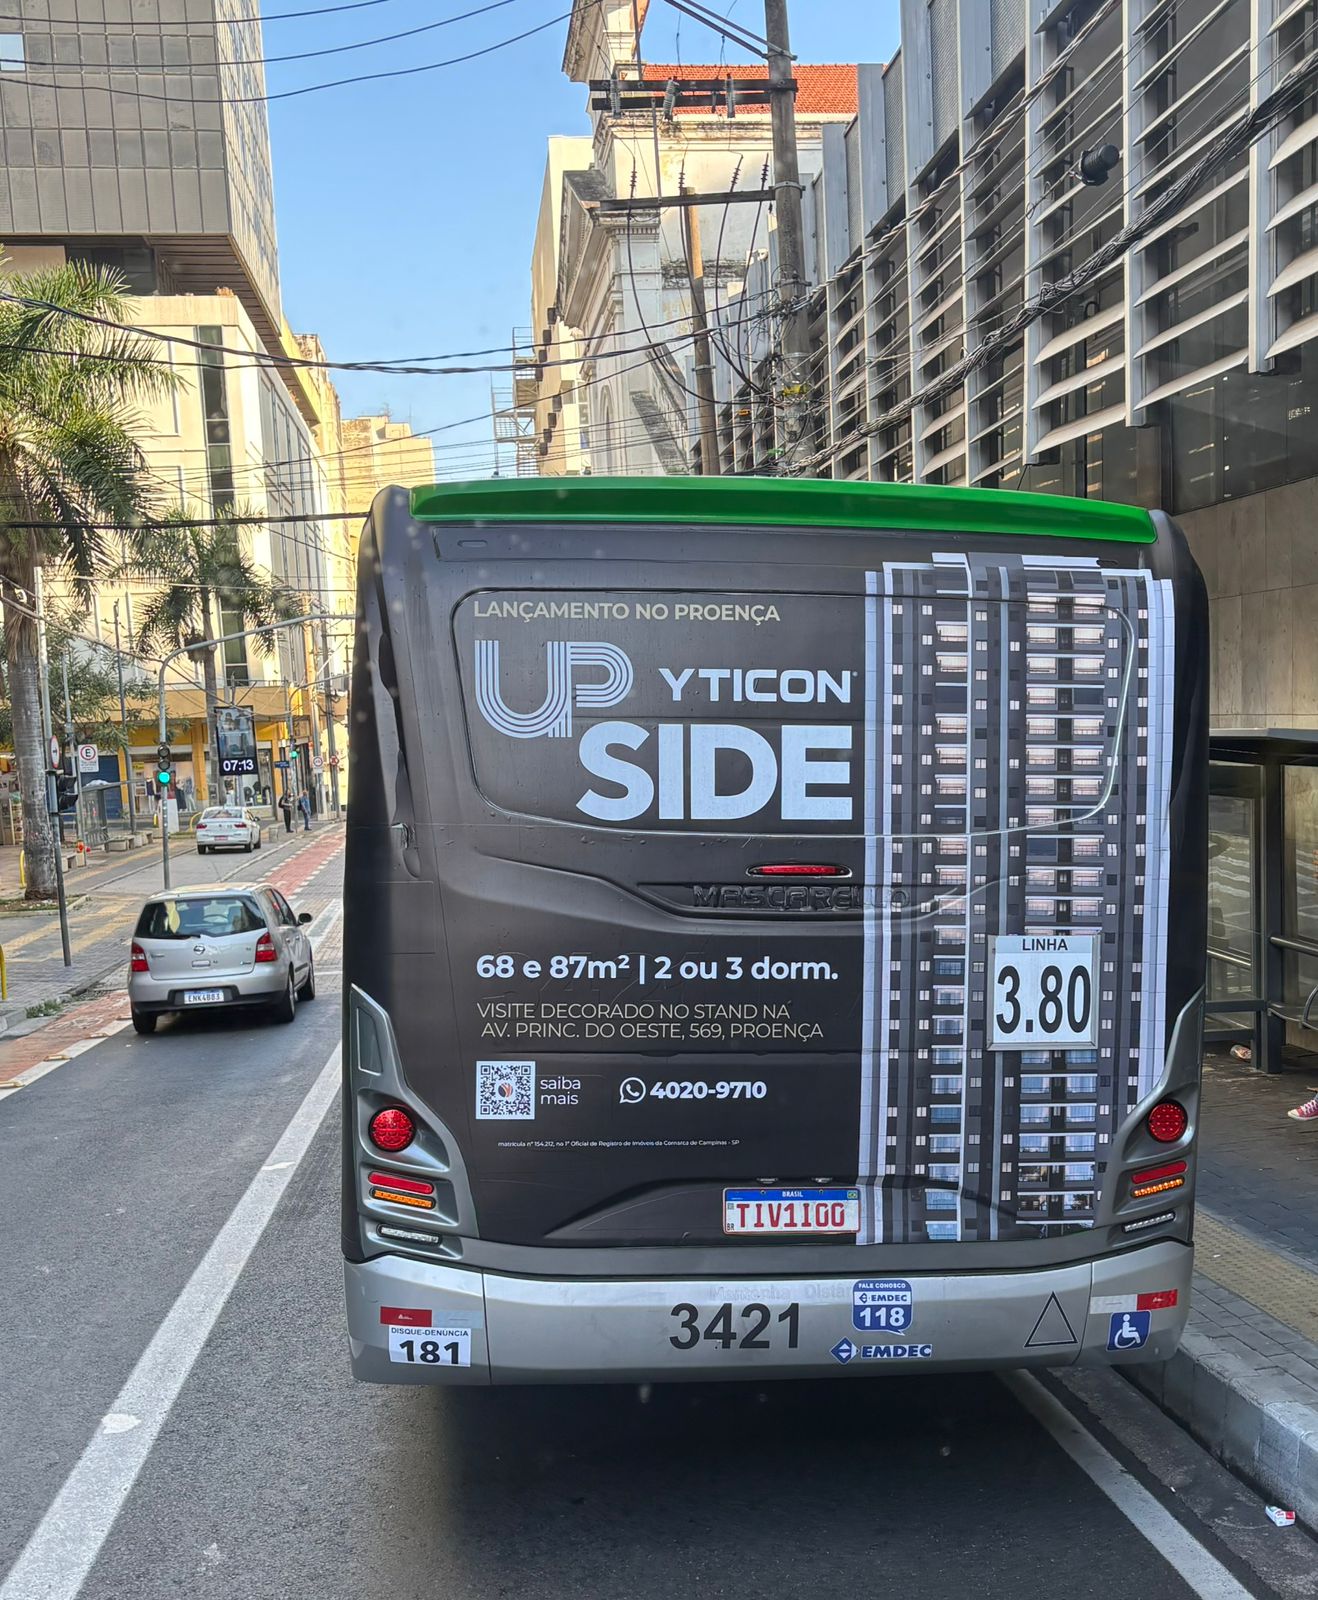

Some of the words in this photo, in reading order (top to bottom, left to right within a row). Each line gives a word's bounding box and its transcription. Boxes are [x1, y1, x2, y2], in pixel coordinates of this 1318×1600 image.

[474, 601, 630, 623] LANÇAMENTO
[635, 603, 669, 620] NO
[674, 604, 781, 626] PROENÇA
[474, 639, 634, 740] UP
[85, 748, 91, 757] E
[223, 759, 254, 772] 07:13
[576, 720, 853, 822] SIDE
[1022, 938, 1069, 951] LINHA
[476, 954, 515, 979] 68
[522, 960, 542, 979] e
[549, 954, 630, 979] 87m²
[654, 956, 672, 979] 2
[679, 961, 718, 980] ou
[725, 957, 743, 980] 3
[751, 955, 838, 980] dorm.
[996, 965, 1091, 1034] 3.80
[476, 1002, 535, 1019] VISITE
[541, 1003, 655, 1019] DECORADO
[660, 1003, 690, 1019] NO
[695, 1004, 758, 1020] STAND
[763, 1004, 790, 1020] NA
[481, 1022, 511, 1038] AV.
[516, 1022, 580, 1038] PRINC.
[585, 1022, 615, 1038] DO
[619, 1022, 685, 1041] OESTE,
[689, 1023, 725, 1041] 569,
[730, 1023, 824, 1042] PROENÇA
[540, 1076, 581, 1090] saiba
[649, 1081, 767, 1099] 4020-9710
[540, 1092, 579, 1105] mais
[782, 1190, 804, 1198] BRASIL
[870, 1294, 908, 1302] EMDEC
[859, 1306, 905, 1327] 118
[669, 1302, 799, 1350] 3421
[399, 1340, 459, 1365] 181
[861, 1344, 932, 1358] EMDEC
